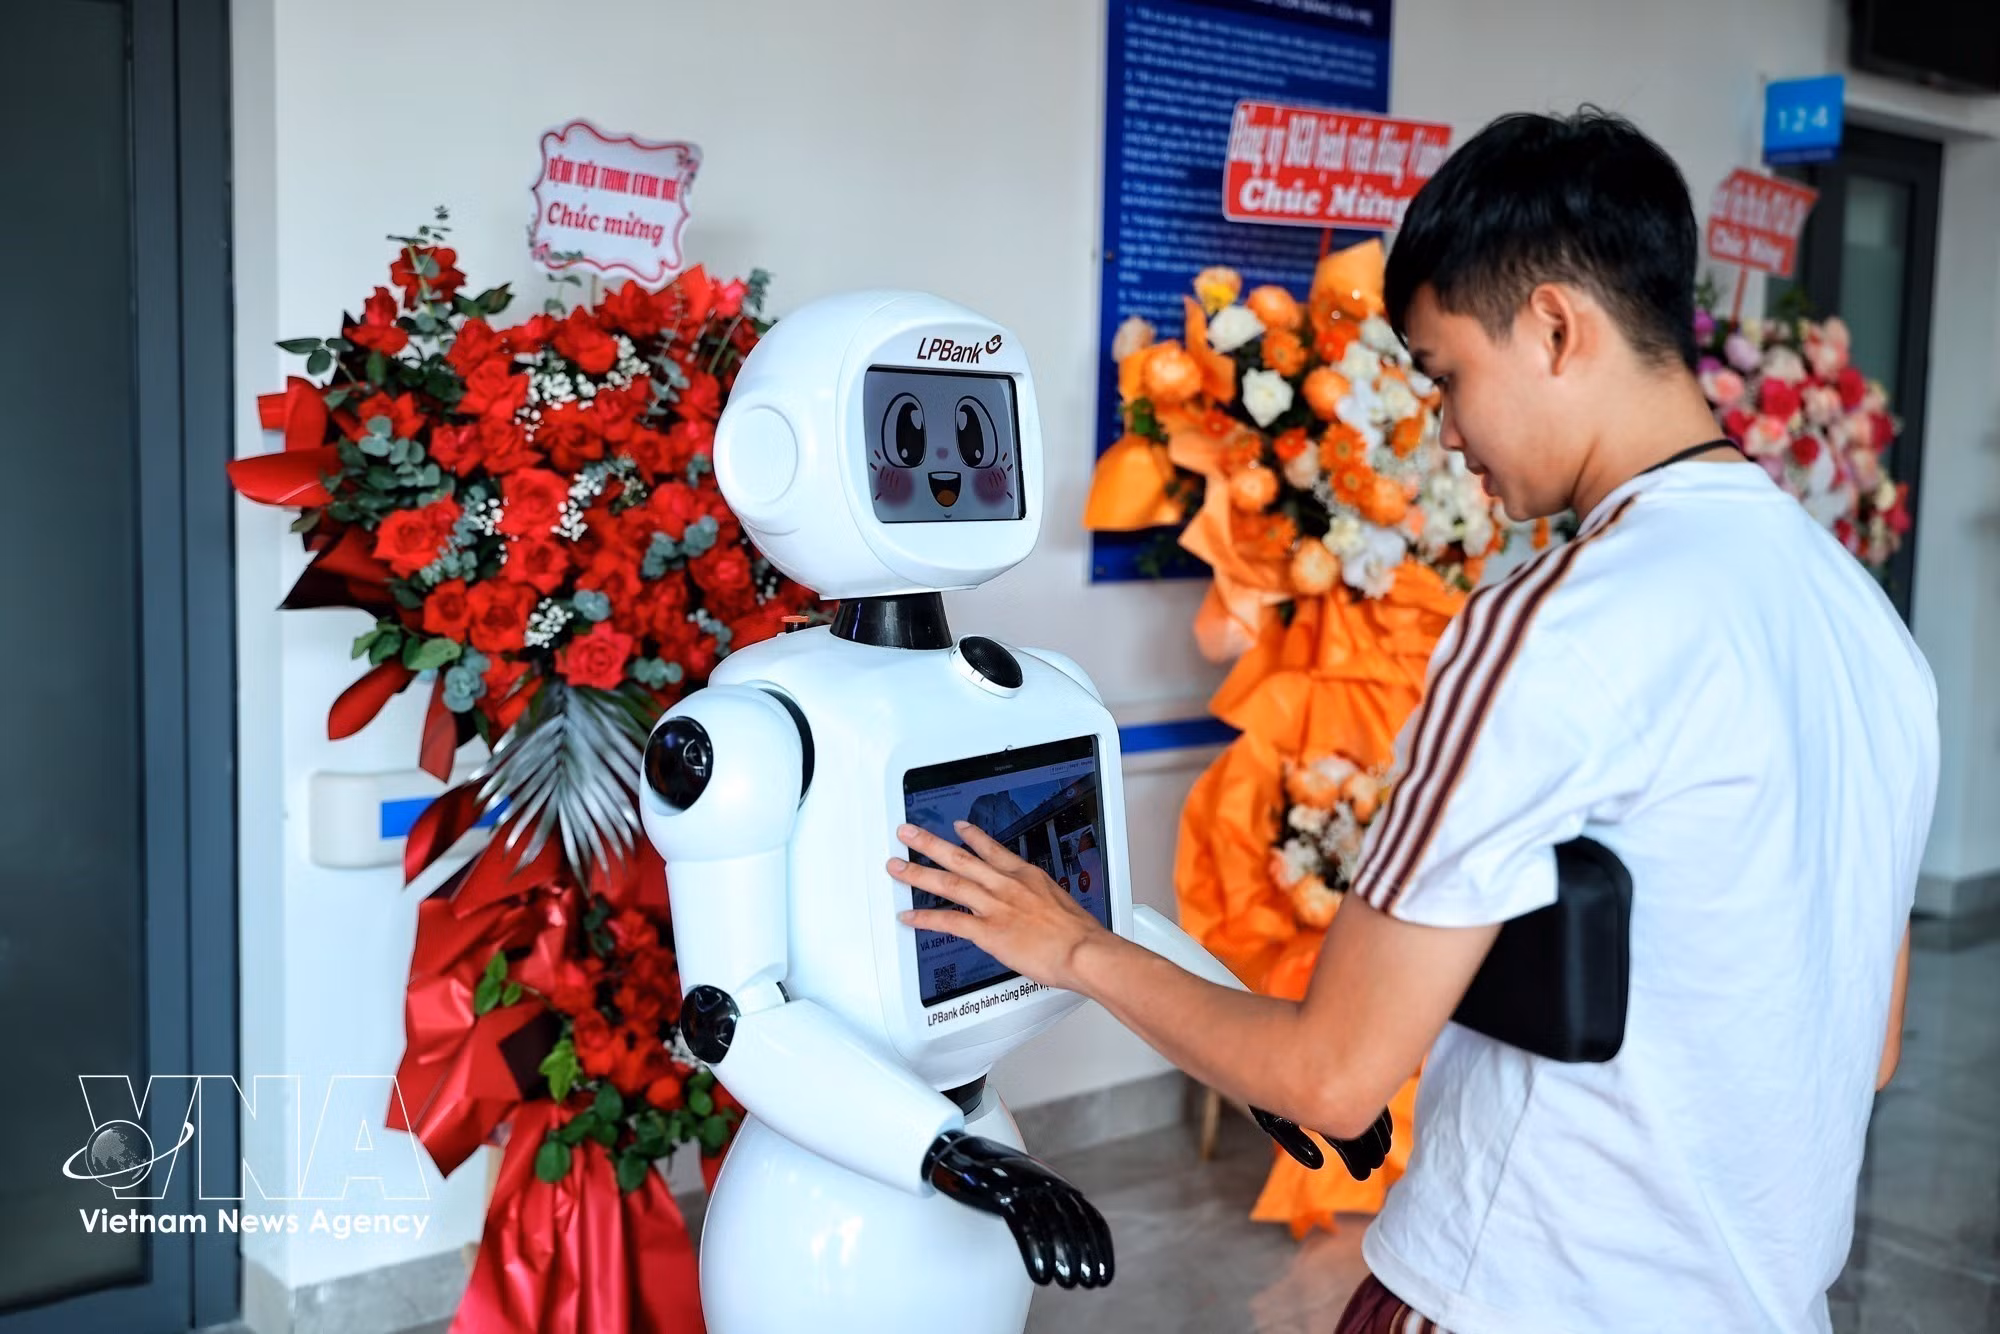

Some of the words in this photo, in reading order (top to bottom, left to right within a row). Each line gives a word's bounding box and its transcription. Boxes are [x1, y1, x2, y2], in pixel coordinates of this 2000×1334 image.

[1239, 178, 1322, 215] Chúc
[548, 202, 600, 232] Chúc
[603, 211, 666, 248] mừng
[916, 337, 984, 364] LPBank
[930, 935, 945, 949] XEM
[927, 1007, 959, 1028] LPBank
[980, 995, 1000, 1010] hành
[1000, 989, 1019, 1003] cùng
[1019, 981, 1039, 997] Bệnh
